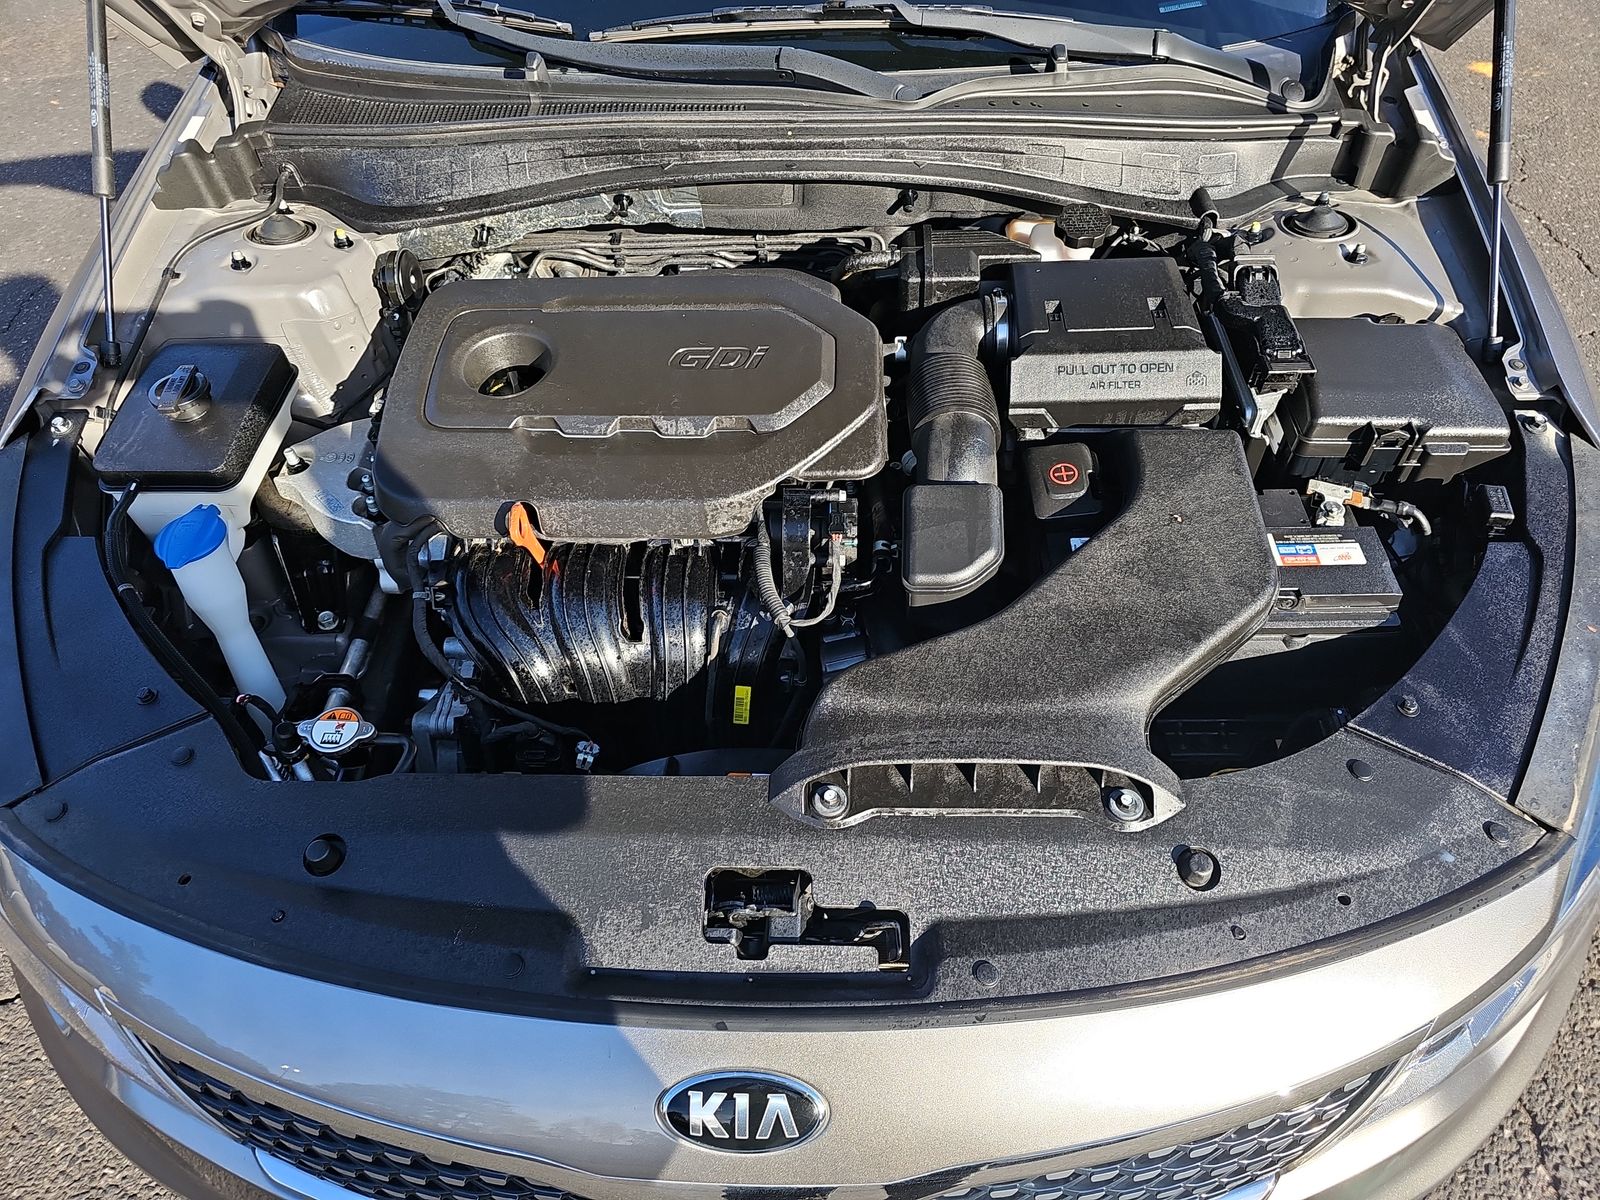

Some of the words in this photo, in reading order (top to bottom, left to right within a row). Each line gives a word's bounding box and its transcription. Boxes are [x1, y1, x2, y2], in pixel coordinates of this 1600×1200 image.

[1057, 365, 1089, 376] PULL
[1092, 363, 1117, 375] OUT
[1120, 363, 1137, 374] TO
[1140, 362, 1174, 374] OPEN
[1089, 381, 1106, 390] AIR
[1108, 380, 1141, 390] FILTER
[687, 1091, 800, 1140] KIA
